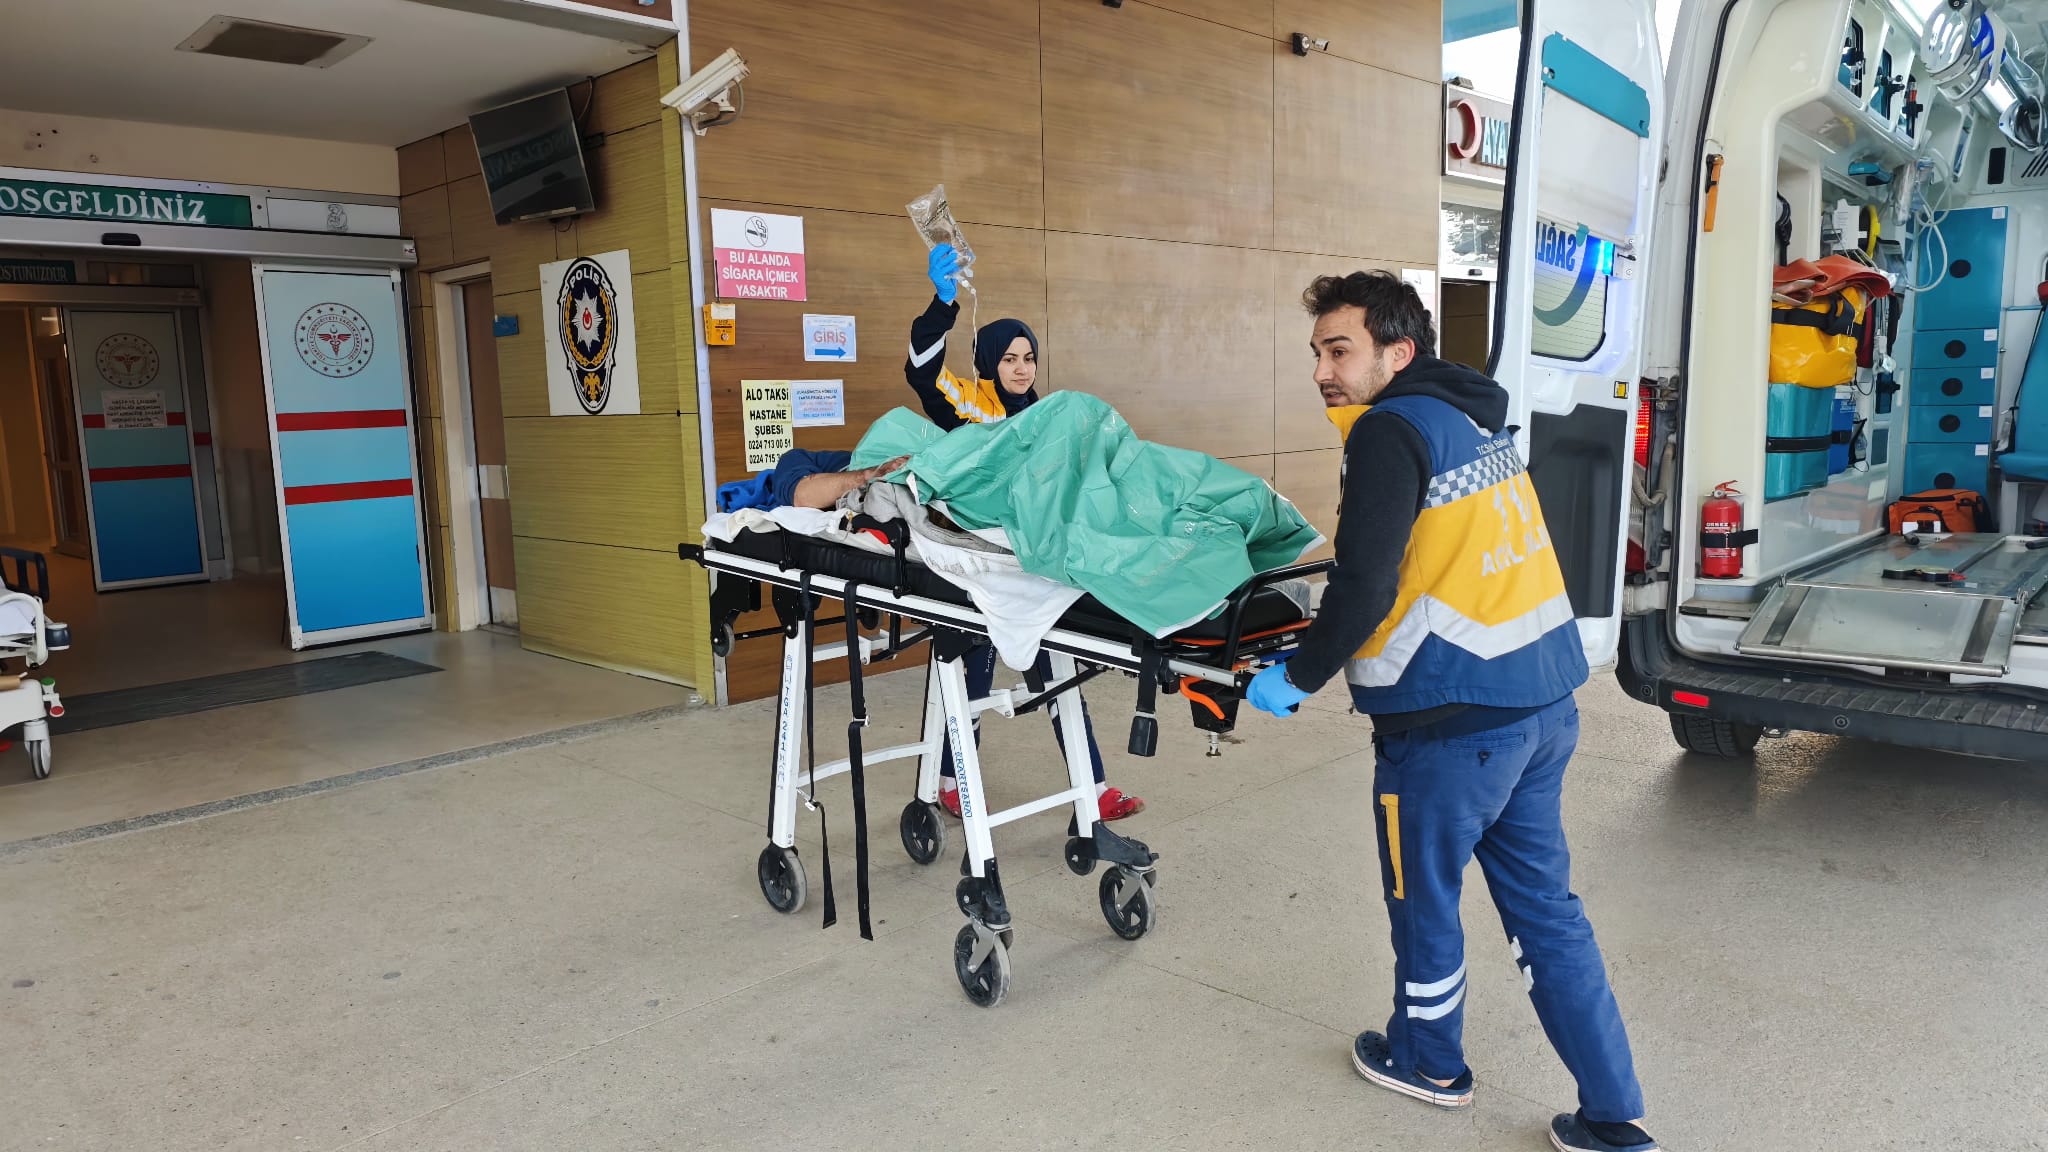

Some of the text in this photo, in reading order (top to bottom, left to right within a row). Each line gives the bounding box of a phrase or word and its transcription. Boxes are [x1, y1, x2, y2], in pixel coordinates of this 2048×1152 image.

[730, 251, 791, 266] BU ALANDA
[570, 266, 600, 288] POLİS
[722, 265, 799, 284] SİGARA İÇMEK
[736, 284, 788, 298] YASAKTIR
[814, 328, 847, 347] GİRİŞ
[746, 388, 763, 401] ALO
[750, 409, 787, 420] HASTANE
[748, 440, 763, 450] 0224
[764, 439, 775, 449] 713
[749, 454, 764, 464] 0224
[765, 453, 776, 463] 715
